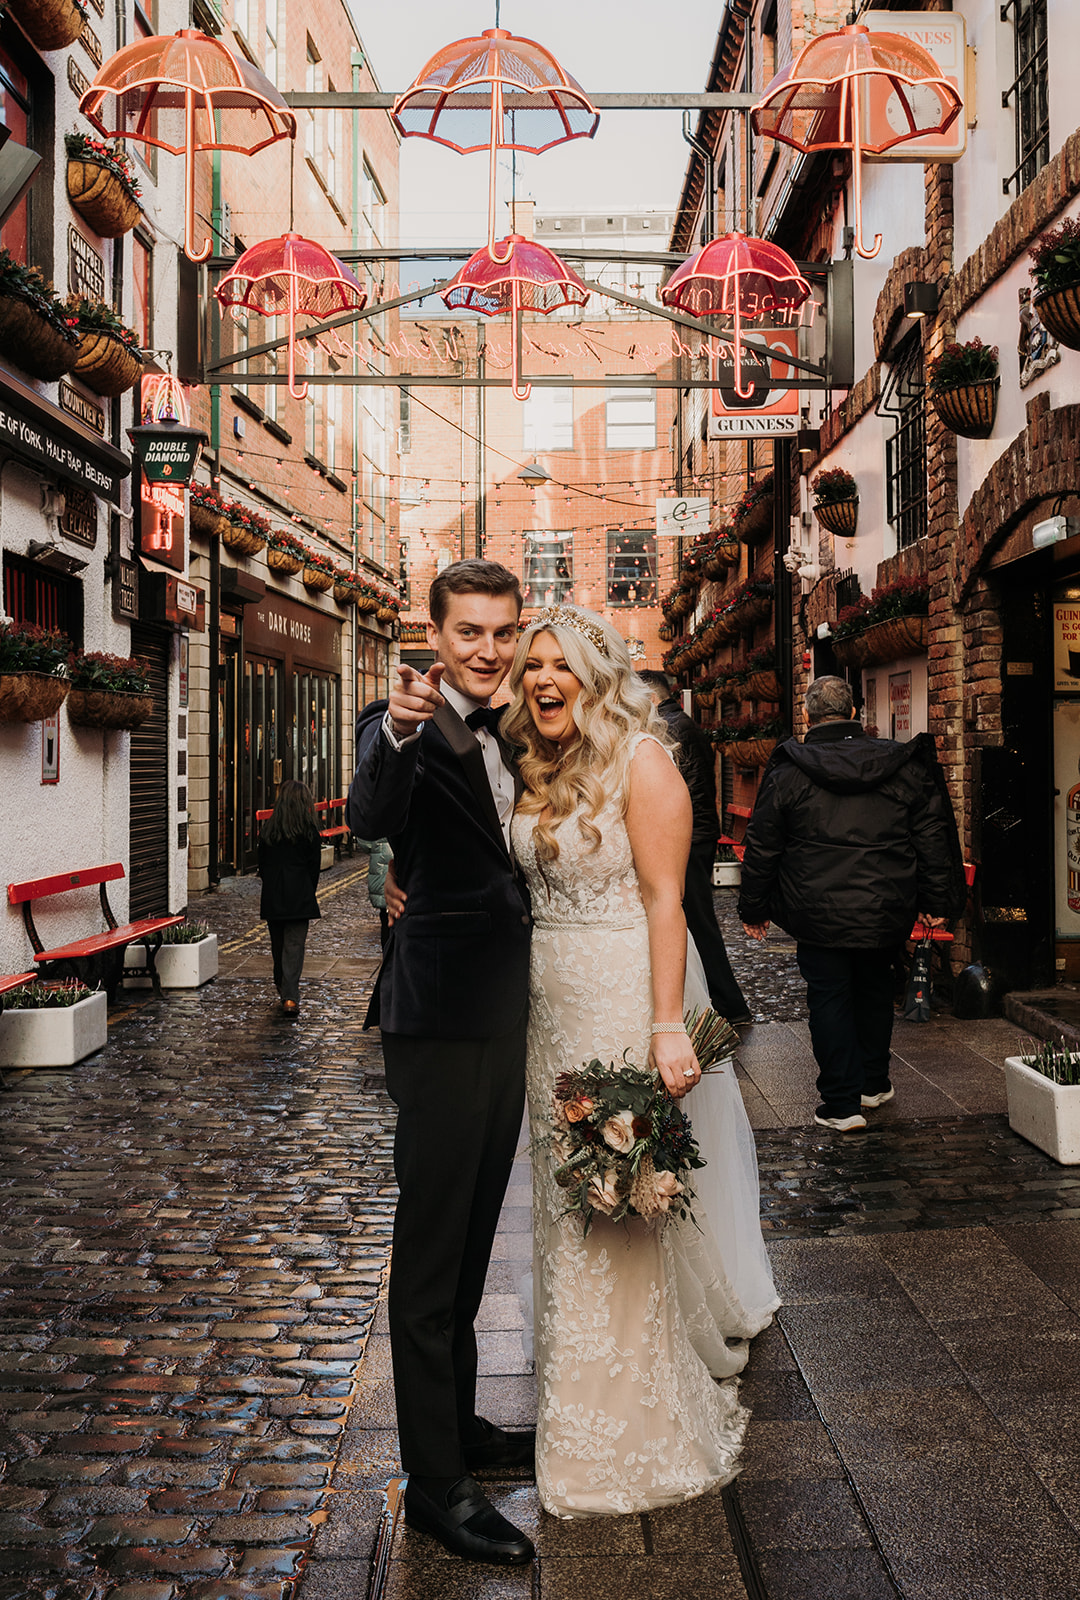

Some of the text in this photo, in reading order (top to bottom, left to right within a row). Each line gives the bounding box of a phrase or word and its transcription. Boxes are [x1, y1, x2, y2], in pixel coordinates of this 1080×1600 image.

[717, 417, 795, 432] GUINNESS
[149, 442, 187, 452] DOUBLE
[7, 416, 18, 436] OF
[46, 437, 67, 463] HALF
[85, 461, 113, 491] BELFAST
[145, 453, 190, 463] DIAMOND
[70, 513, 91, 540] PLACE
[257, 611, 311, 644] THE DARK HORSE
[1062, 623, 1070, 631] IS
[1063, 632, 1077, 641] FOR
